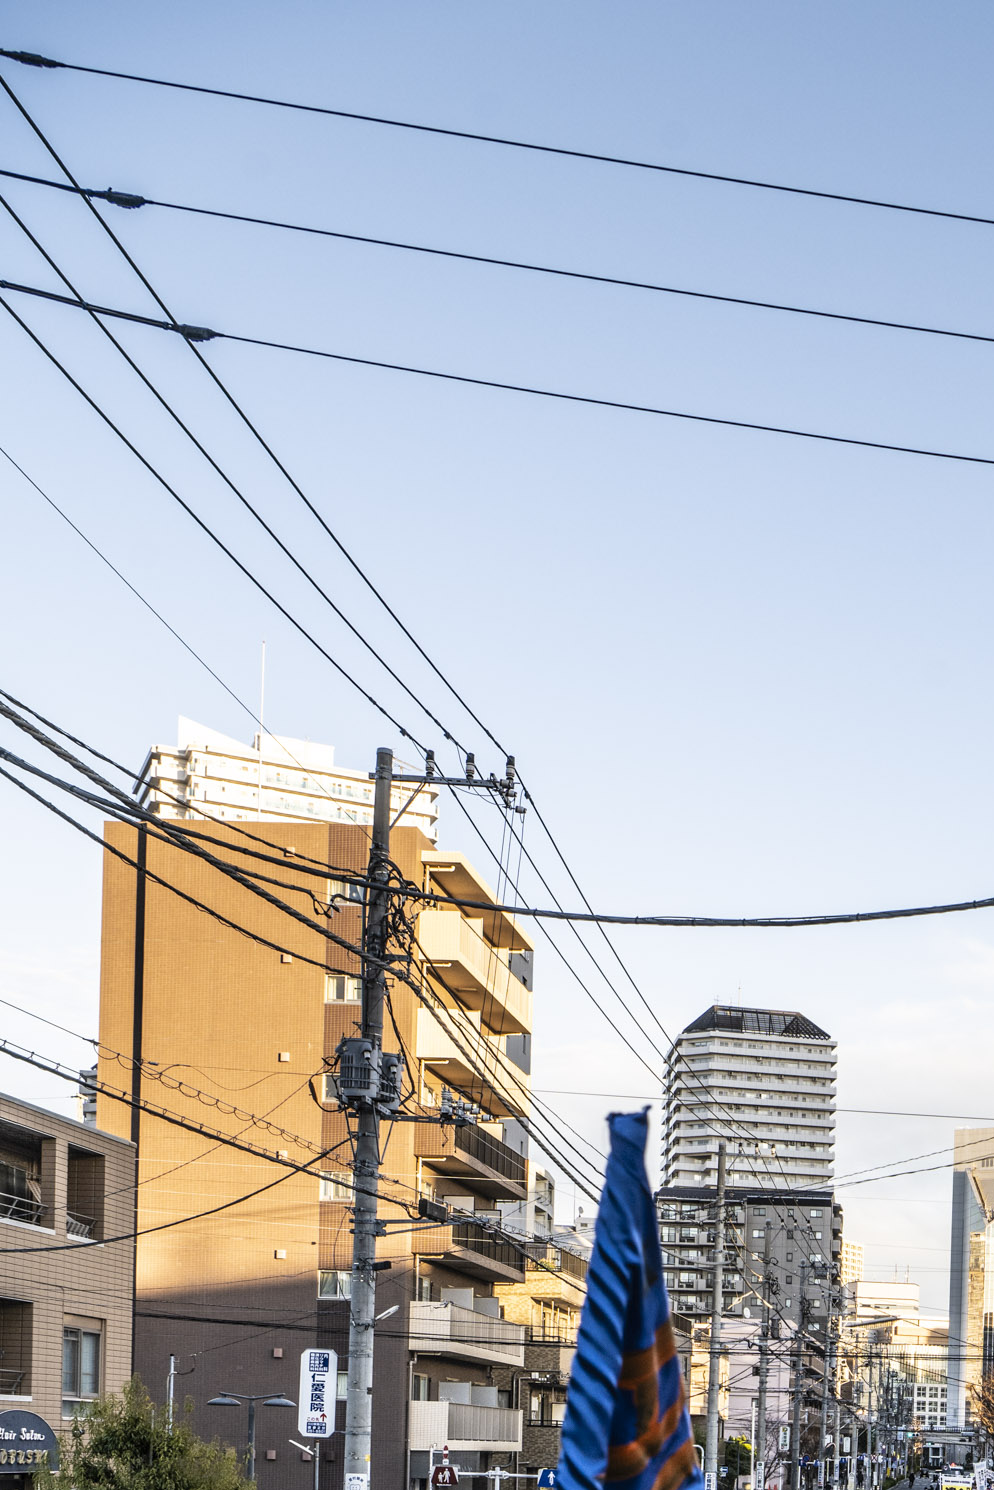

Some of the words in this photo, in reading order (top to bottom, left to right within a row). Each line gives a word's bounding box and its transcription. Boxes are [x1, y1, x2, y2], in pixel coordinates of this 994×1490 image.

[310, 1372, 326, 1412] 仁愛医院
[20, 1427, 46, 1440] Salon
